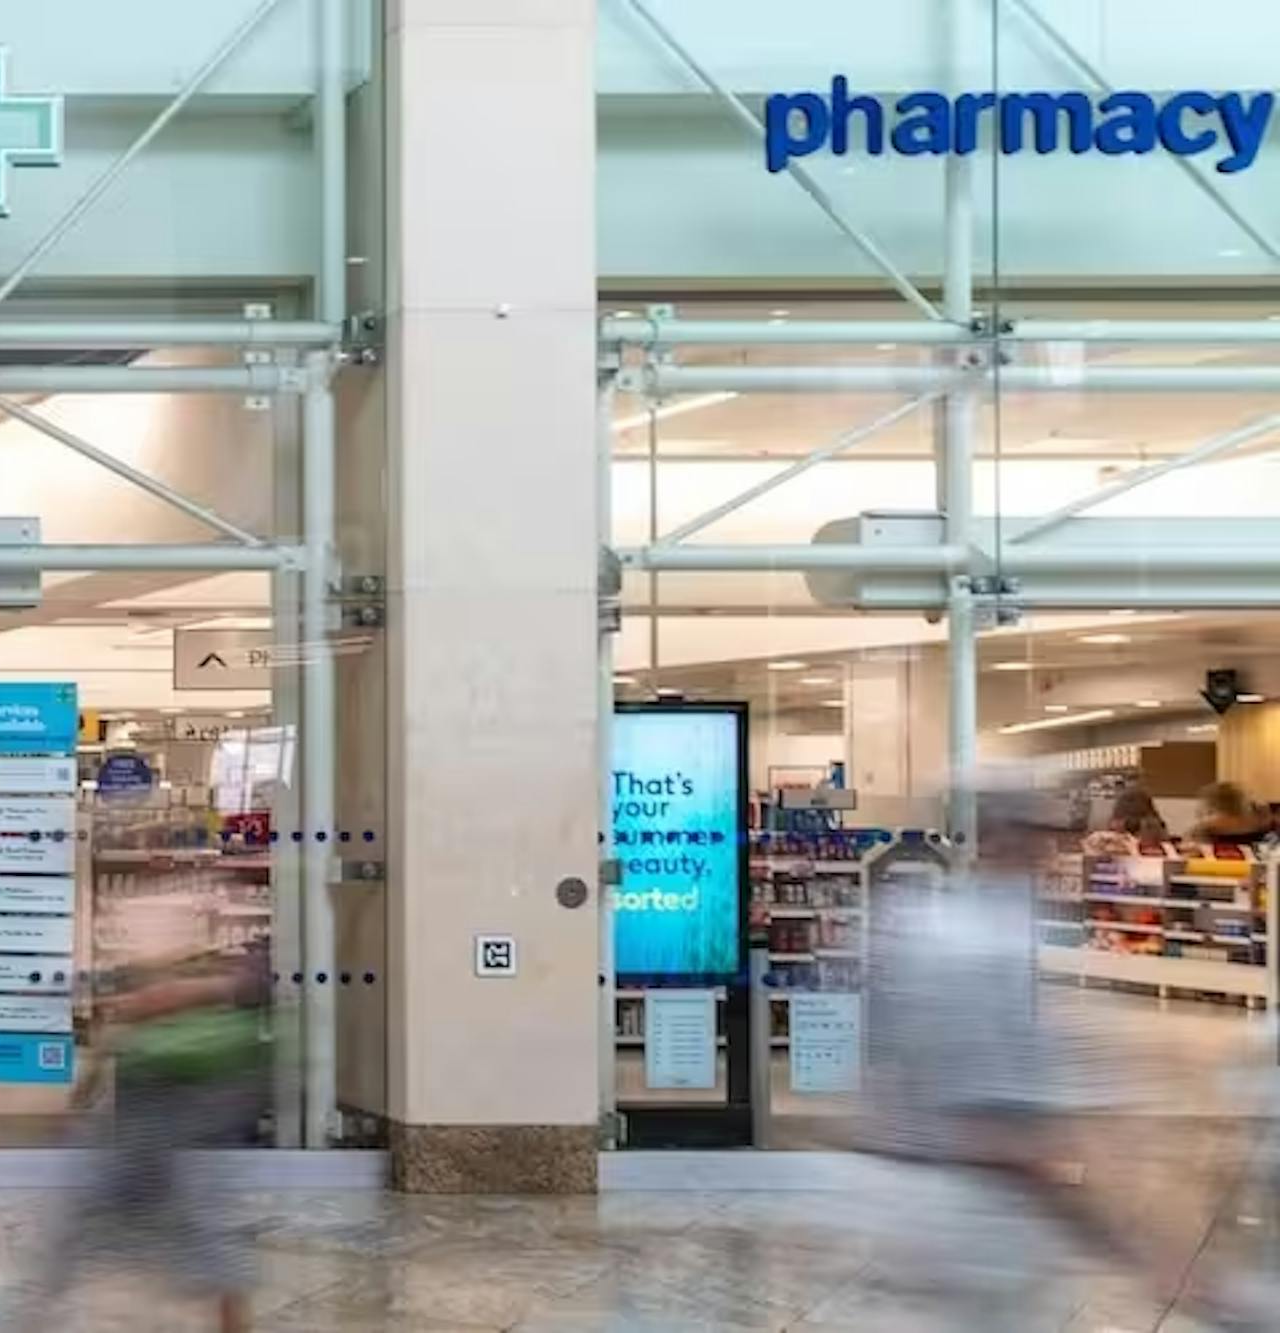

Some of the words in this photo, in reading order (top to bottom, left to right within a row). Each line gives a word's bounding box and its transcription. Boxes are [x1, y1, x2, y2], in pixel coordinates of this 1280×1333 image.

[765, 75, 1277, 172] pharmacy
[613, 769, 694, 796] That's
[613, 801, 670, 825] your
[628, 853, 713, 882] eauty,
